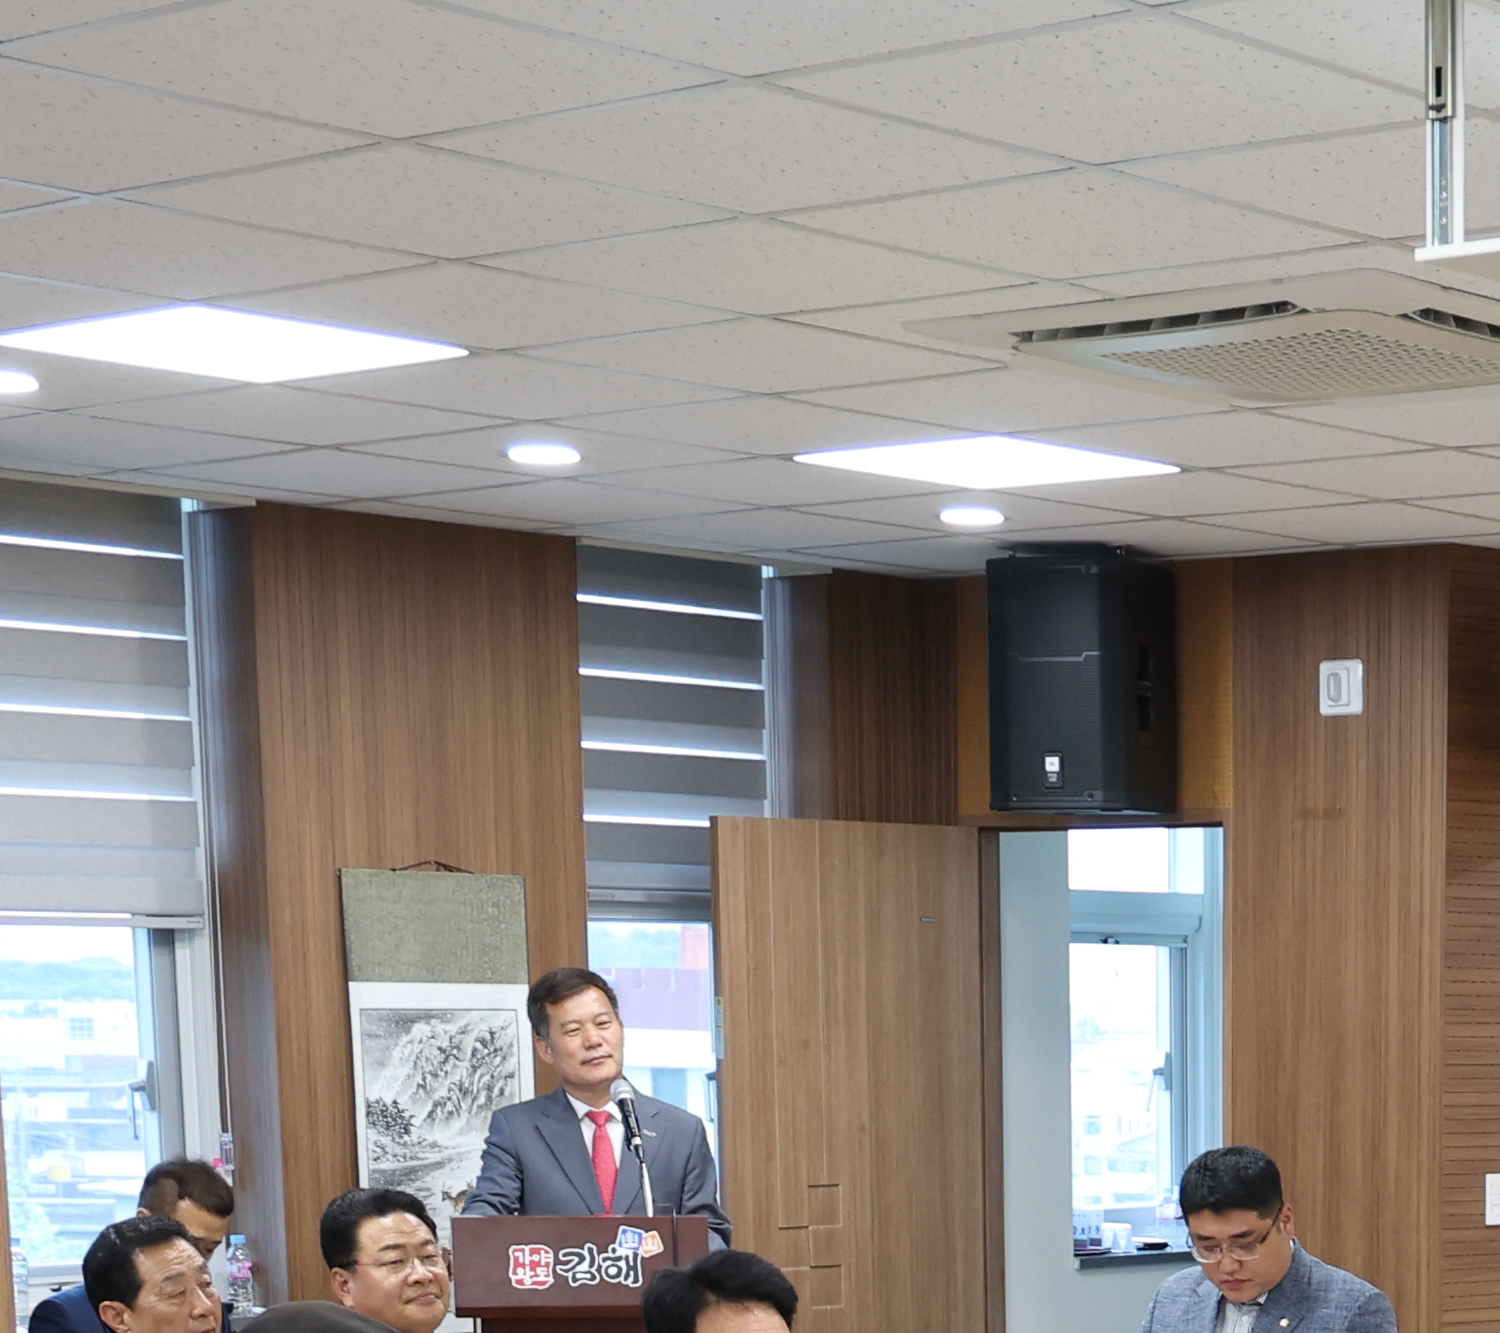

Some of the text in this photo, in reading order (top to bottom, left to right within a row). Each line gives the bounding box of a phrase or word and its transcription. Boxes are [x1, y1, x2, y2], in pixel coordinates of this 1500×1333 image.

[514, 1250, 551, 1266] 가야
[557, 1243, 642, 1287] 김해
[514, 1266, 550, 1285] 왕도
